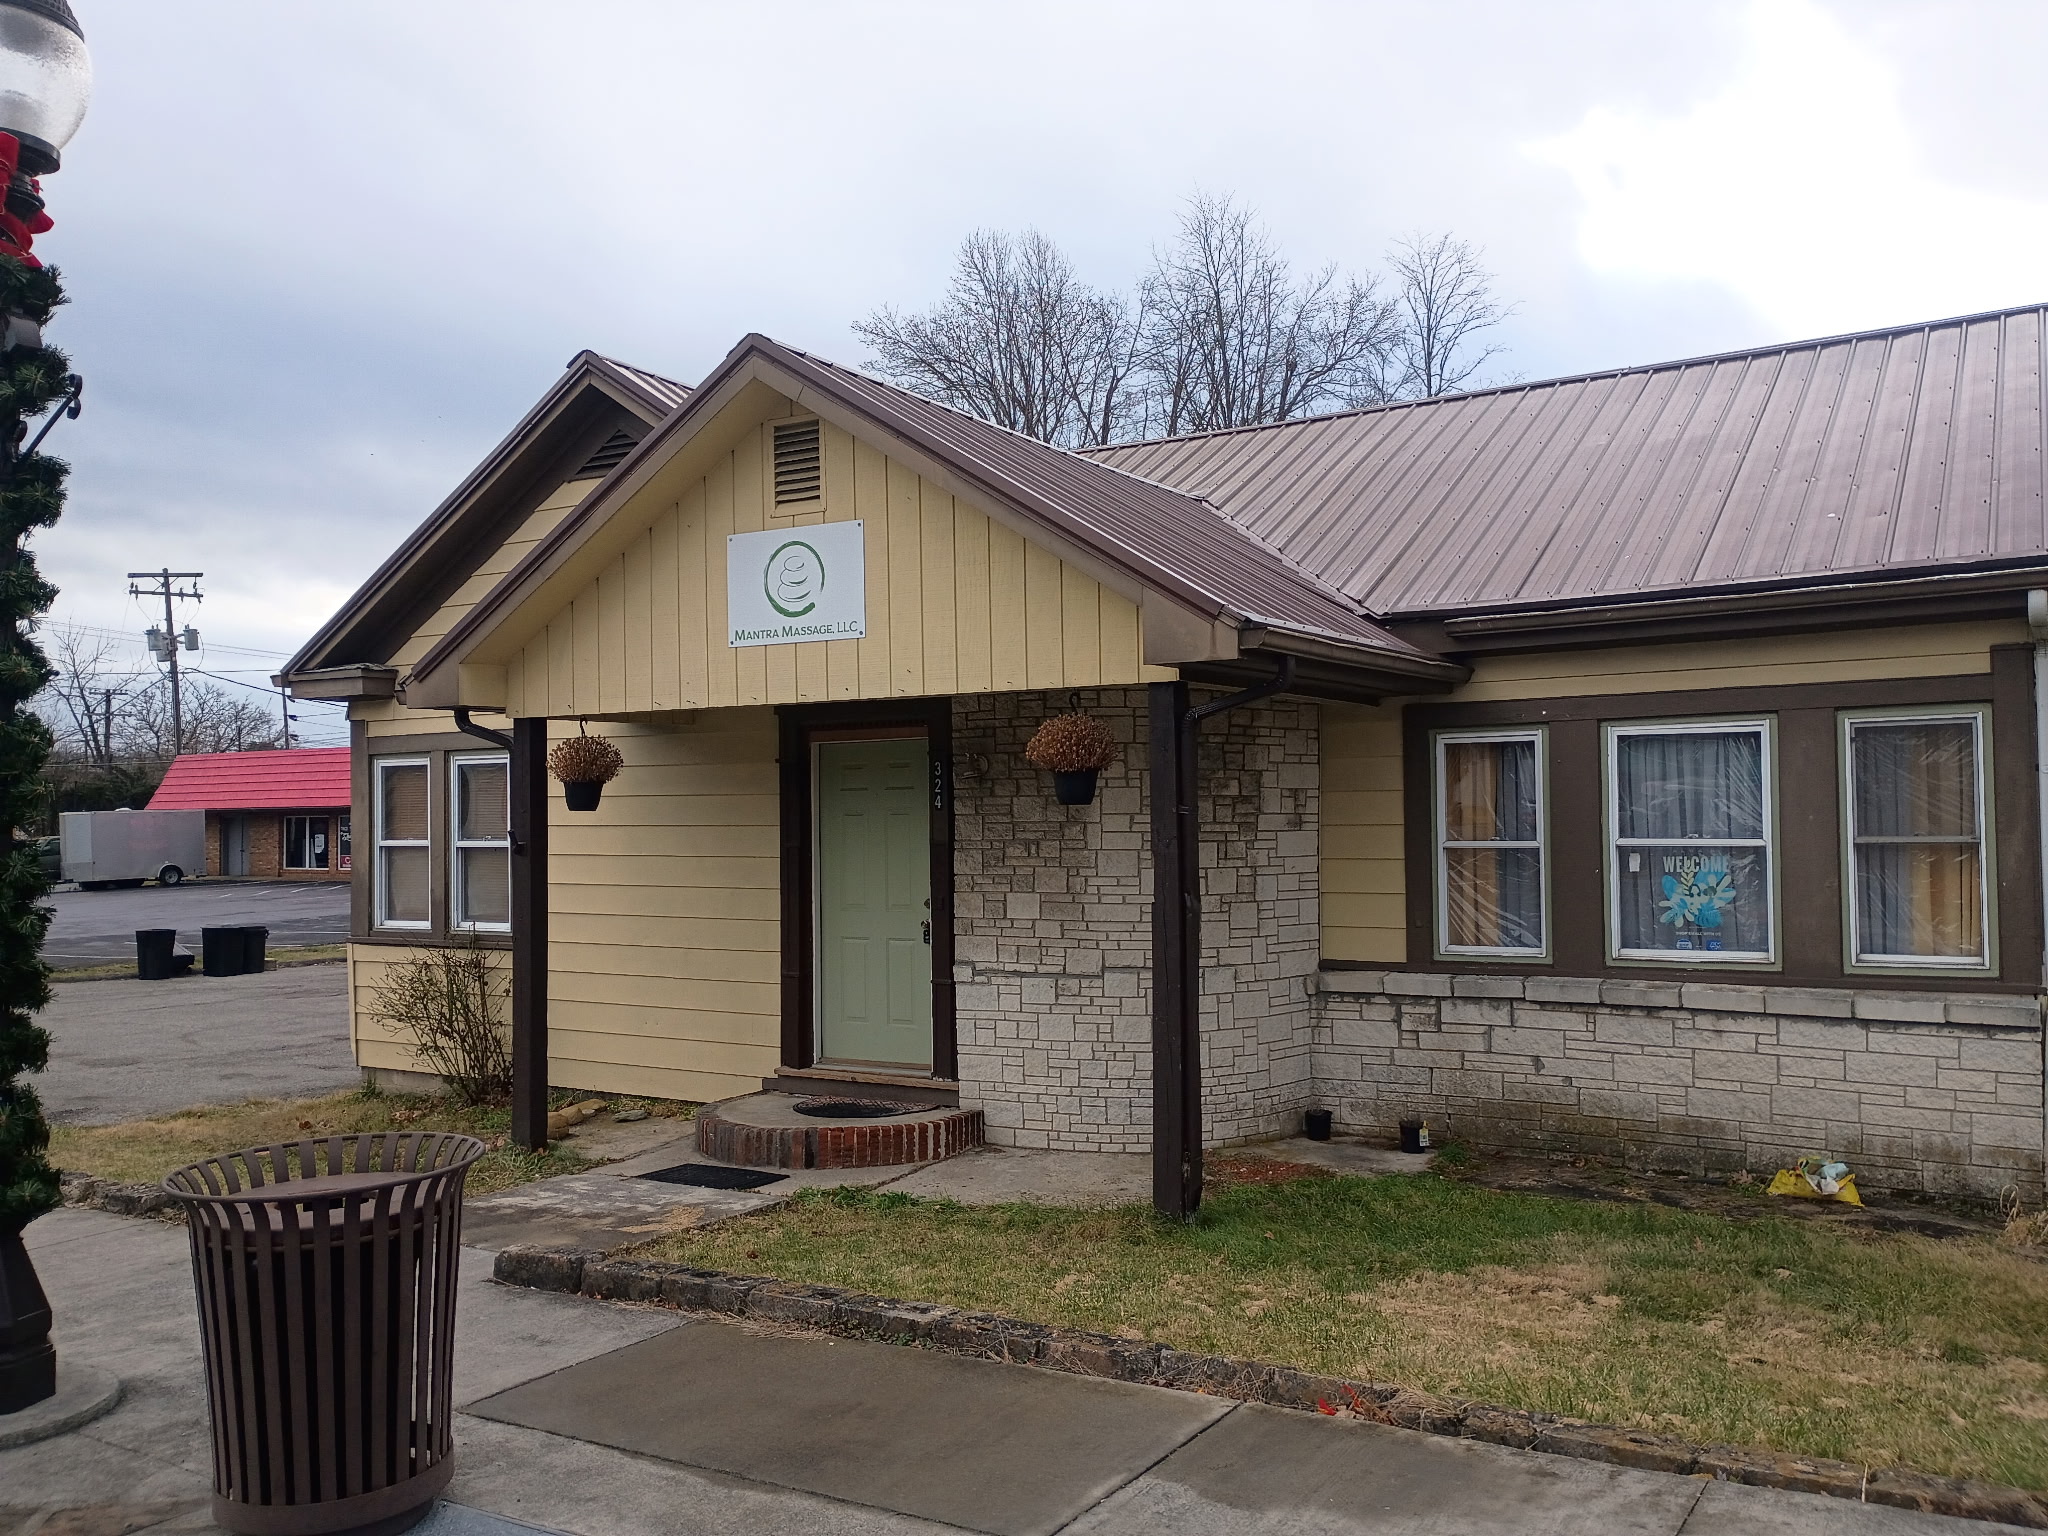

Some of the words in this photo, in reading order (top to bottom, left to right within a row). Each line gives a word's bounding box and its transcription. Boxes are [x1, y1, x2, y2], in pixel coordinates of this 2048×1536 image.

[837, 621, 858, 634] LLC
[934, 761, 942, 809] 324
[1662, 855, 1730, 873] WELCOME
